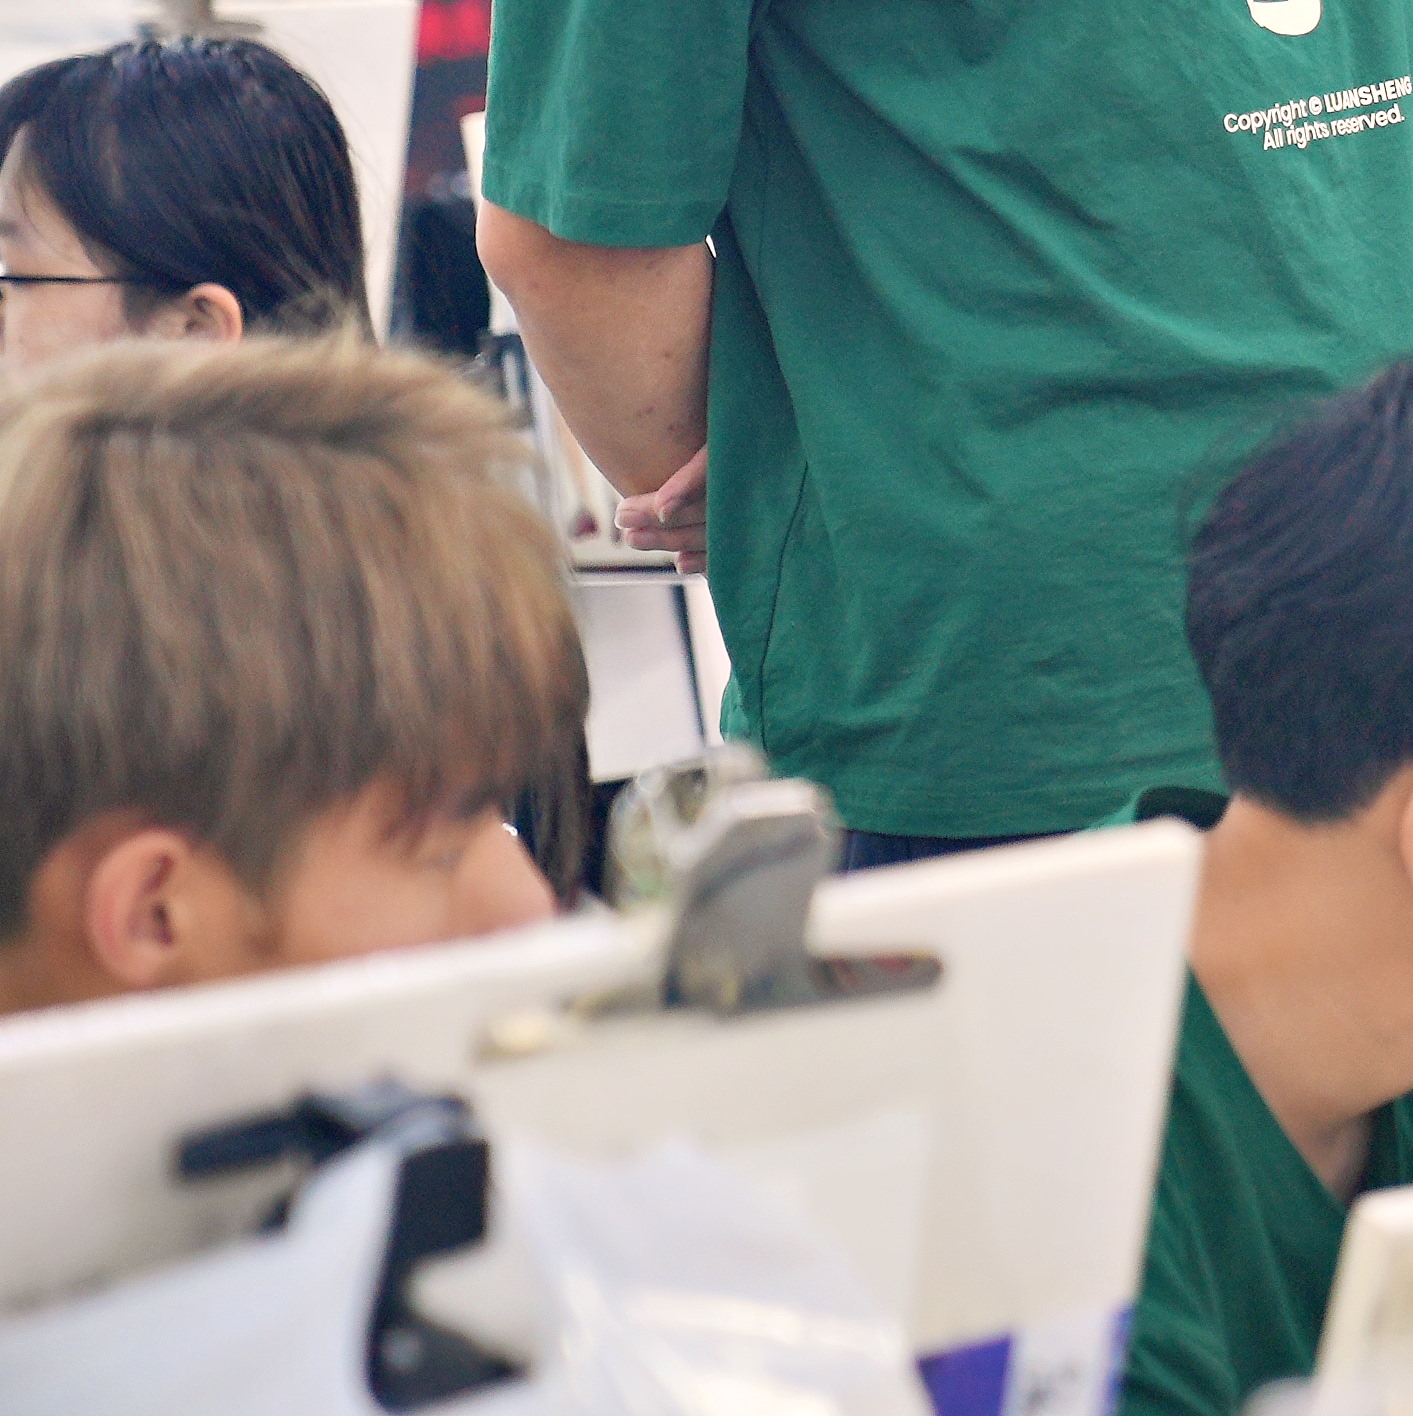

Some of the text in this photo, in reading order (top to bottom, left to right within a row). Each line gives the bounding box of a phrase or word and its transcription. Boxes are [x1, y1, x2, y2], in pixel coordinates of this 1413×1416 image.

[1223, 98, 1308, 133] Copyright
[1324, 75, 1412, 113] LUANSHENG
[1263, 103, 1405, 150] All rights reserved.
